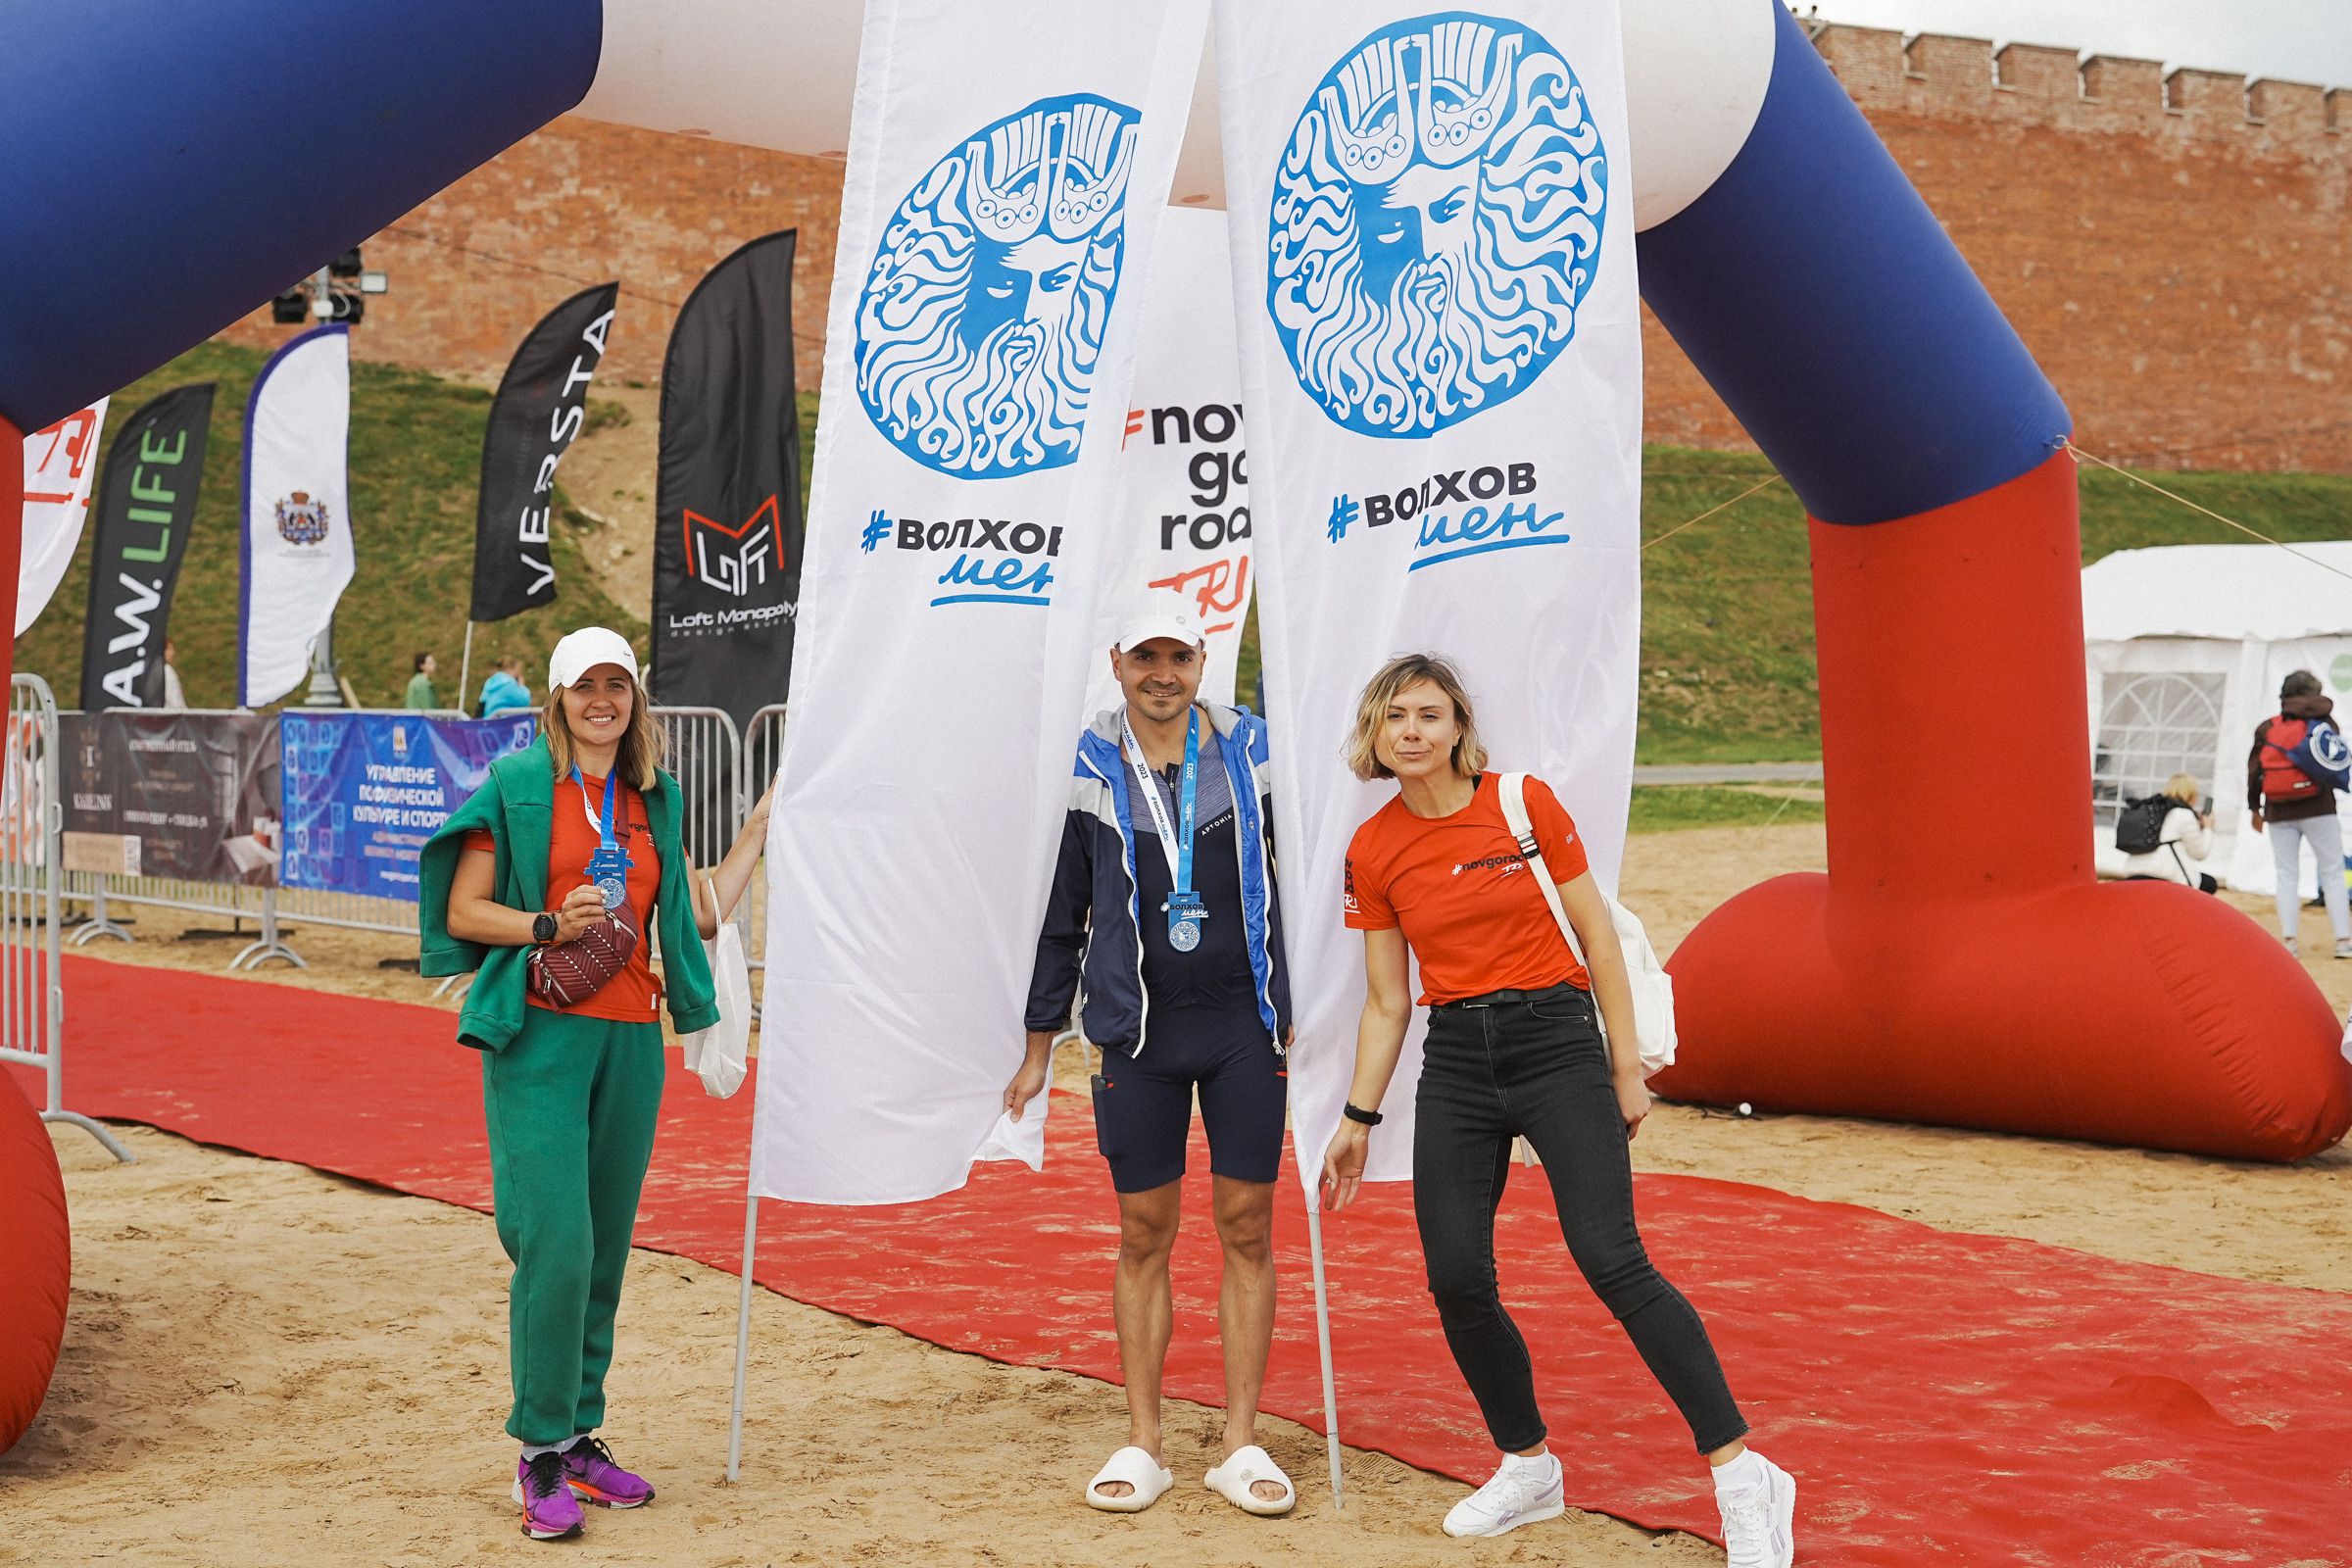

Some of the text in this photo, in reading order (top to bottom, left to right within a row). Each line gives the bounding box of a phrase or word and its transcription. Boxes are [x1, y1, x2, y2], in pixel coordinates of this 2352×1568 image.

[518, 309, 615, 596] VERSTA
[670, 612, 714, 628] Loft
[1137, 762, 1149, 780] 2023
[1186, 762, 1195, 780] 2023
[1201, 813, 1233, 836] APTONIA
